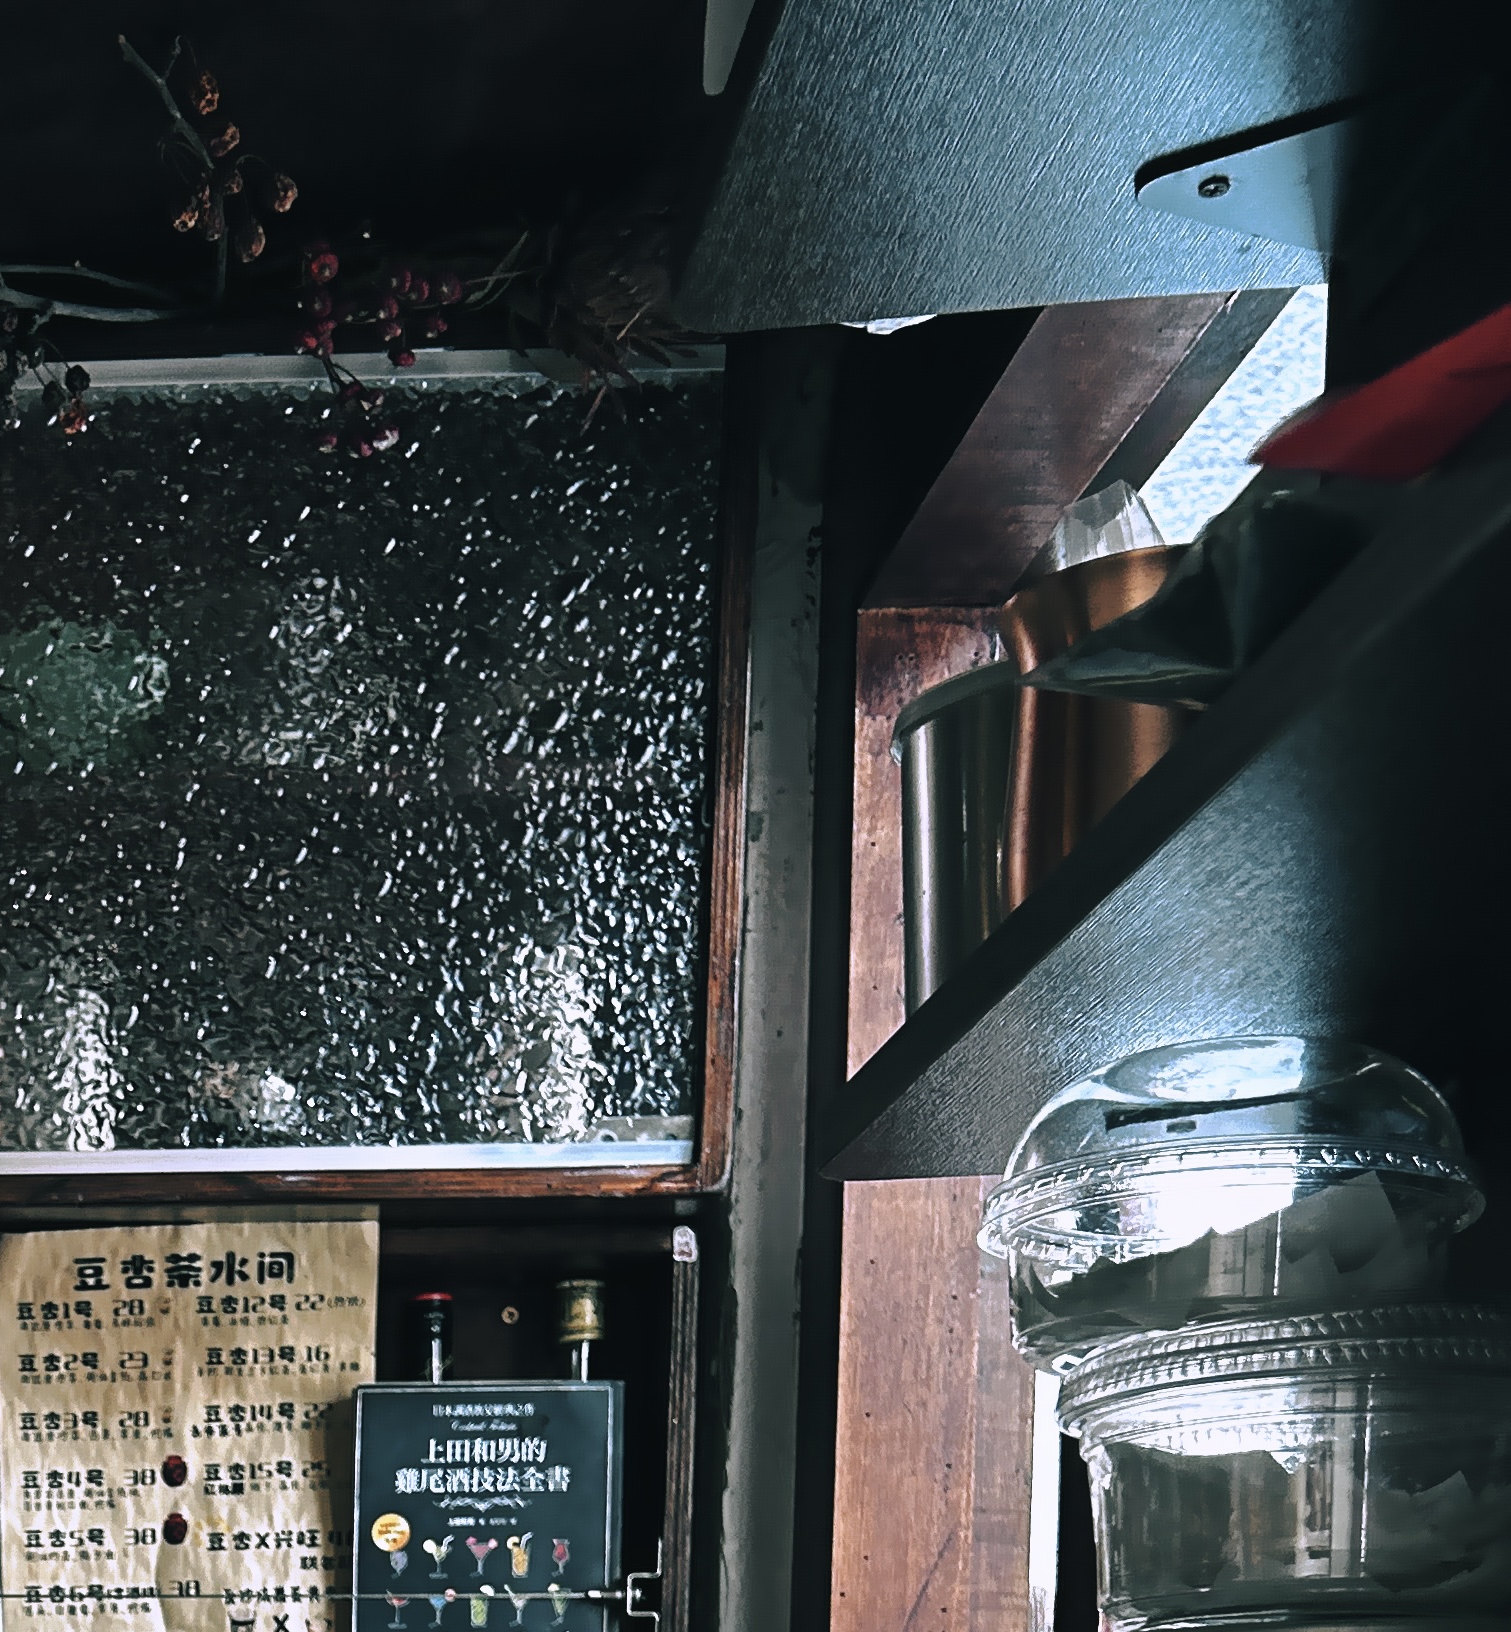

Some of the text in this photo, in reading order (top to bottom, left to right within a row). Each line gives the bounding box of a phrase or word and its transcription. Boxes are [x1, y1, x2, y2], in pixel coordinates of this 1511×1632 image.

[73, 1251, 295, 1291] 豆杏茶水间
[420, 1436, 548, 1464] 上田和男的
